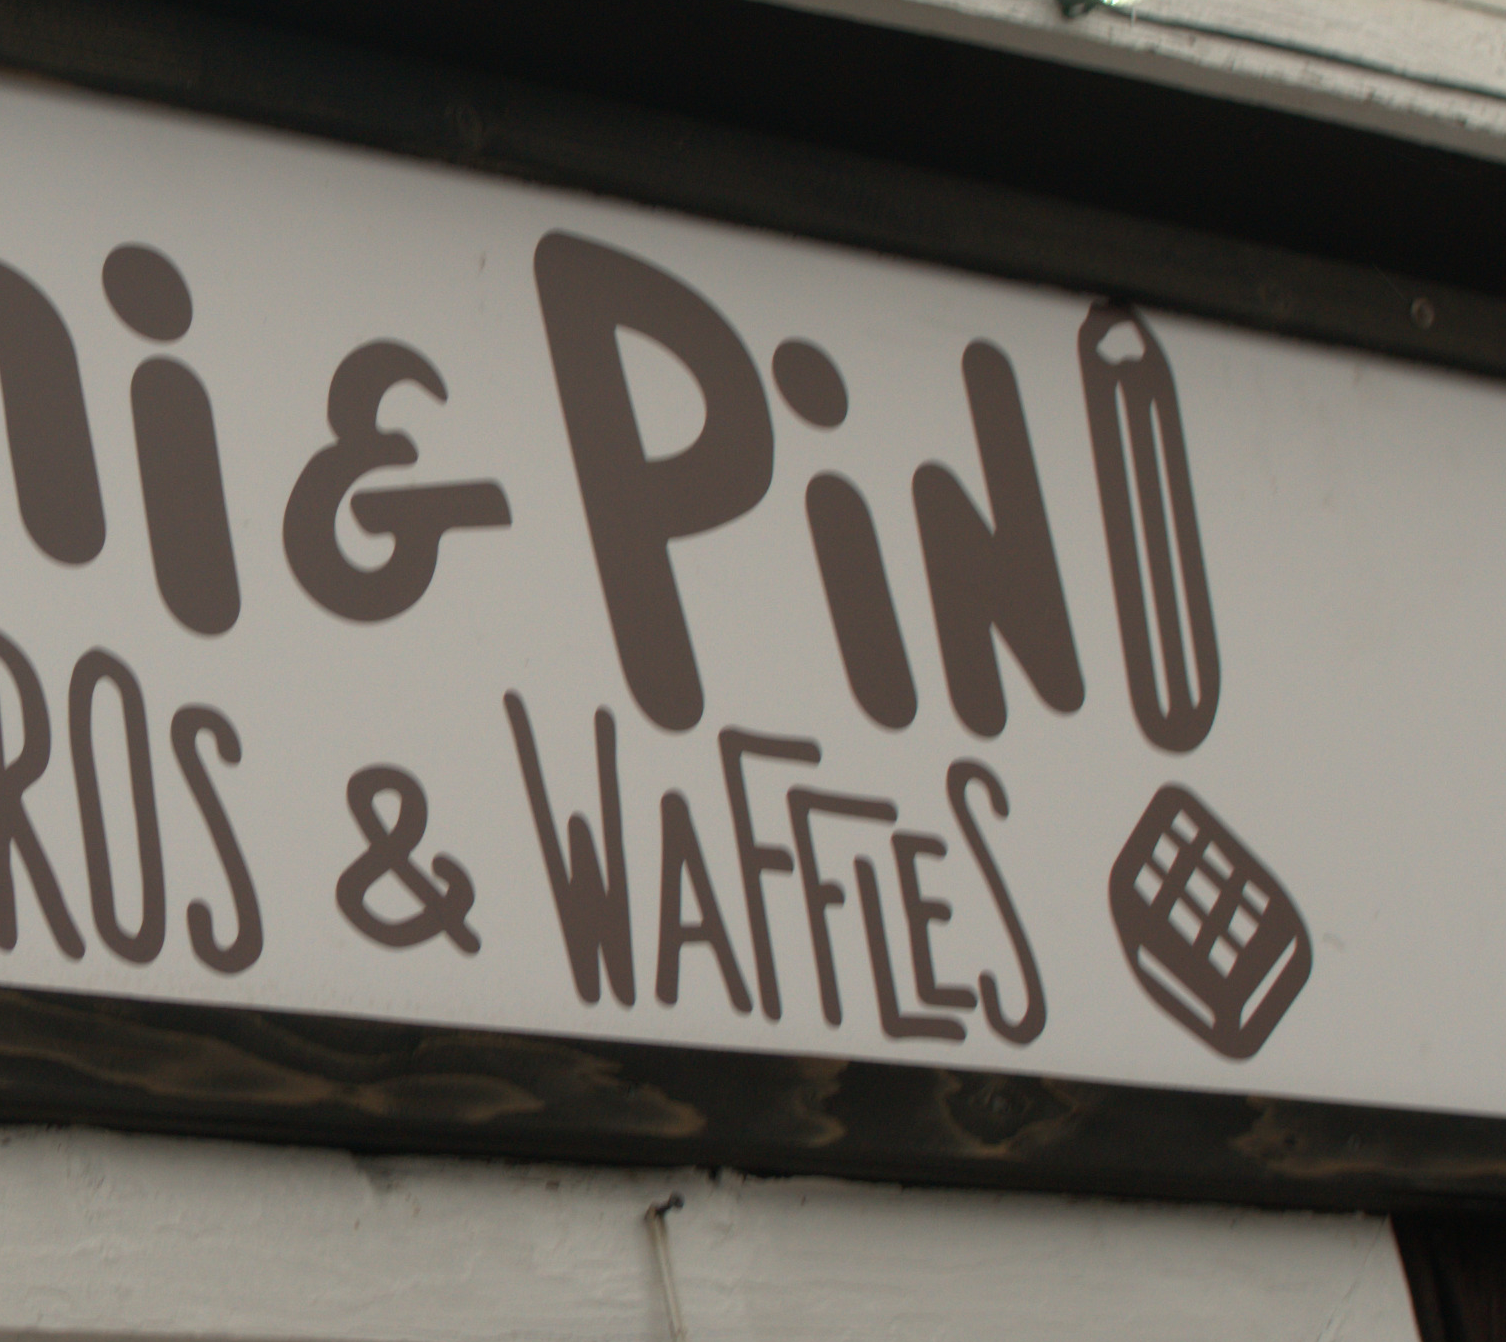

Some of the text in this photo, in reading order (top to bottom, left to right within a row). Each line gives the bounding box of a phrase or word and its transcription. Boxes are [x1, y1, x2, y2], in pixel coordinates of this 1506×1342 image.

[282, 338, 513, 624] &
[335, 764, 482, 956] &
[503, 690, 1048, 1048] WAFFLES
